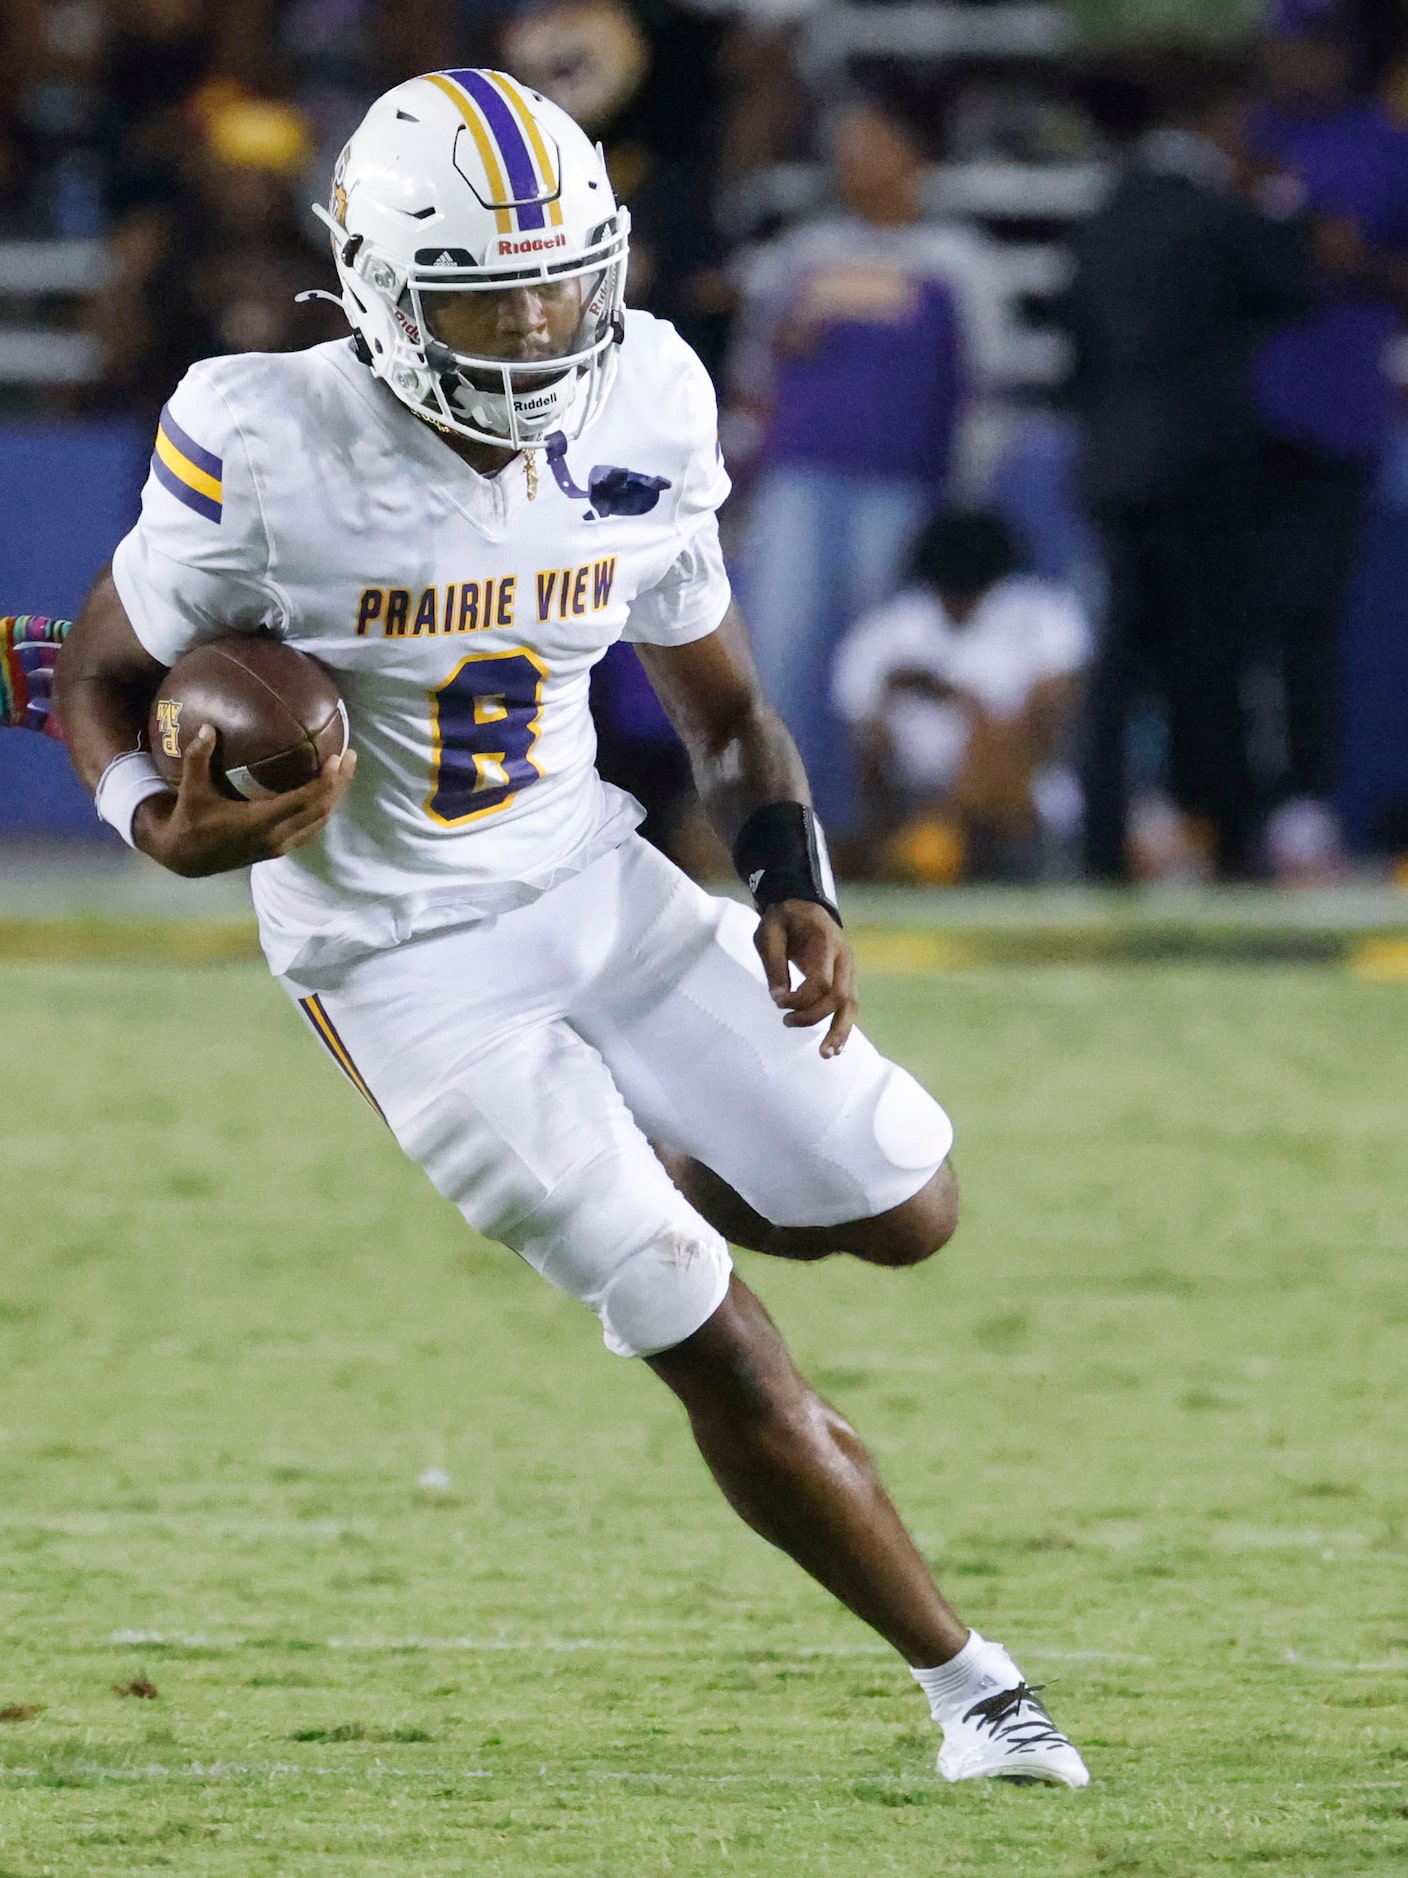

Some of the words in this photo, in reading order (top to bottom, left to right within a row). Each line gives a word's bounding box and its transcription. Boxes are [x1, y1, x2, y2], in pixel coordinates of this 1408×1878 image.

[498, 233, 566, 255] Riddell
[513, 391, 557, 411] Riddell
[356, 573, 518, 638] PRAIRIE
[535, 553, 617, 623] VIEW
[422, 646, 551, 829] 8
